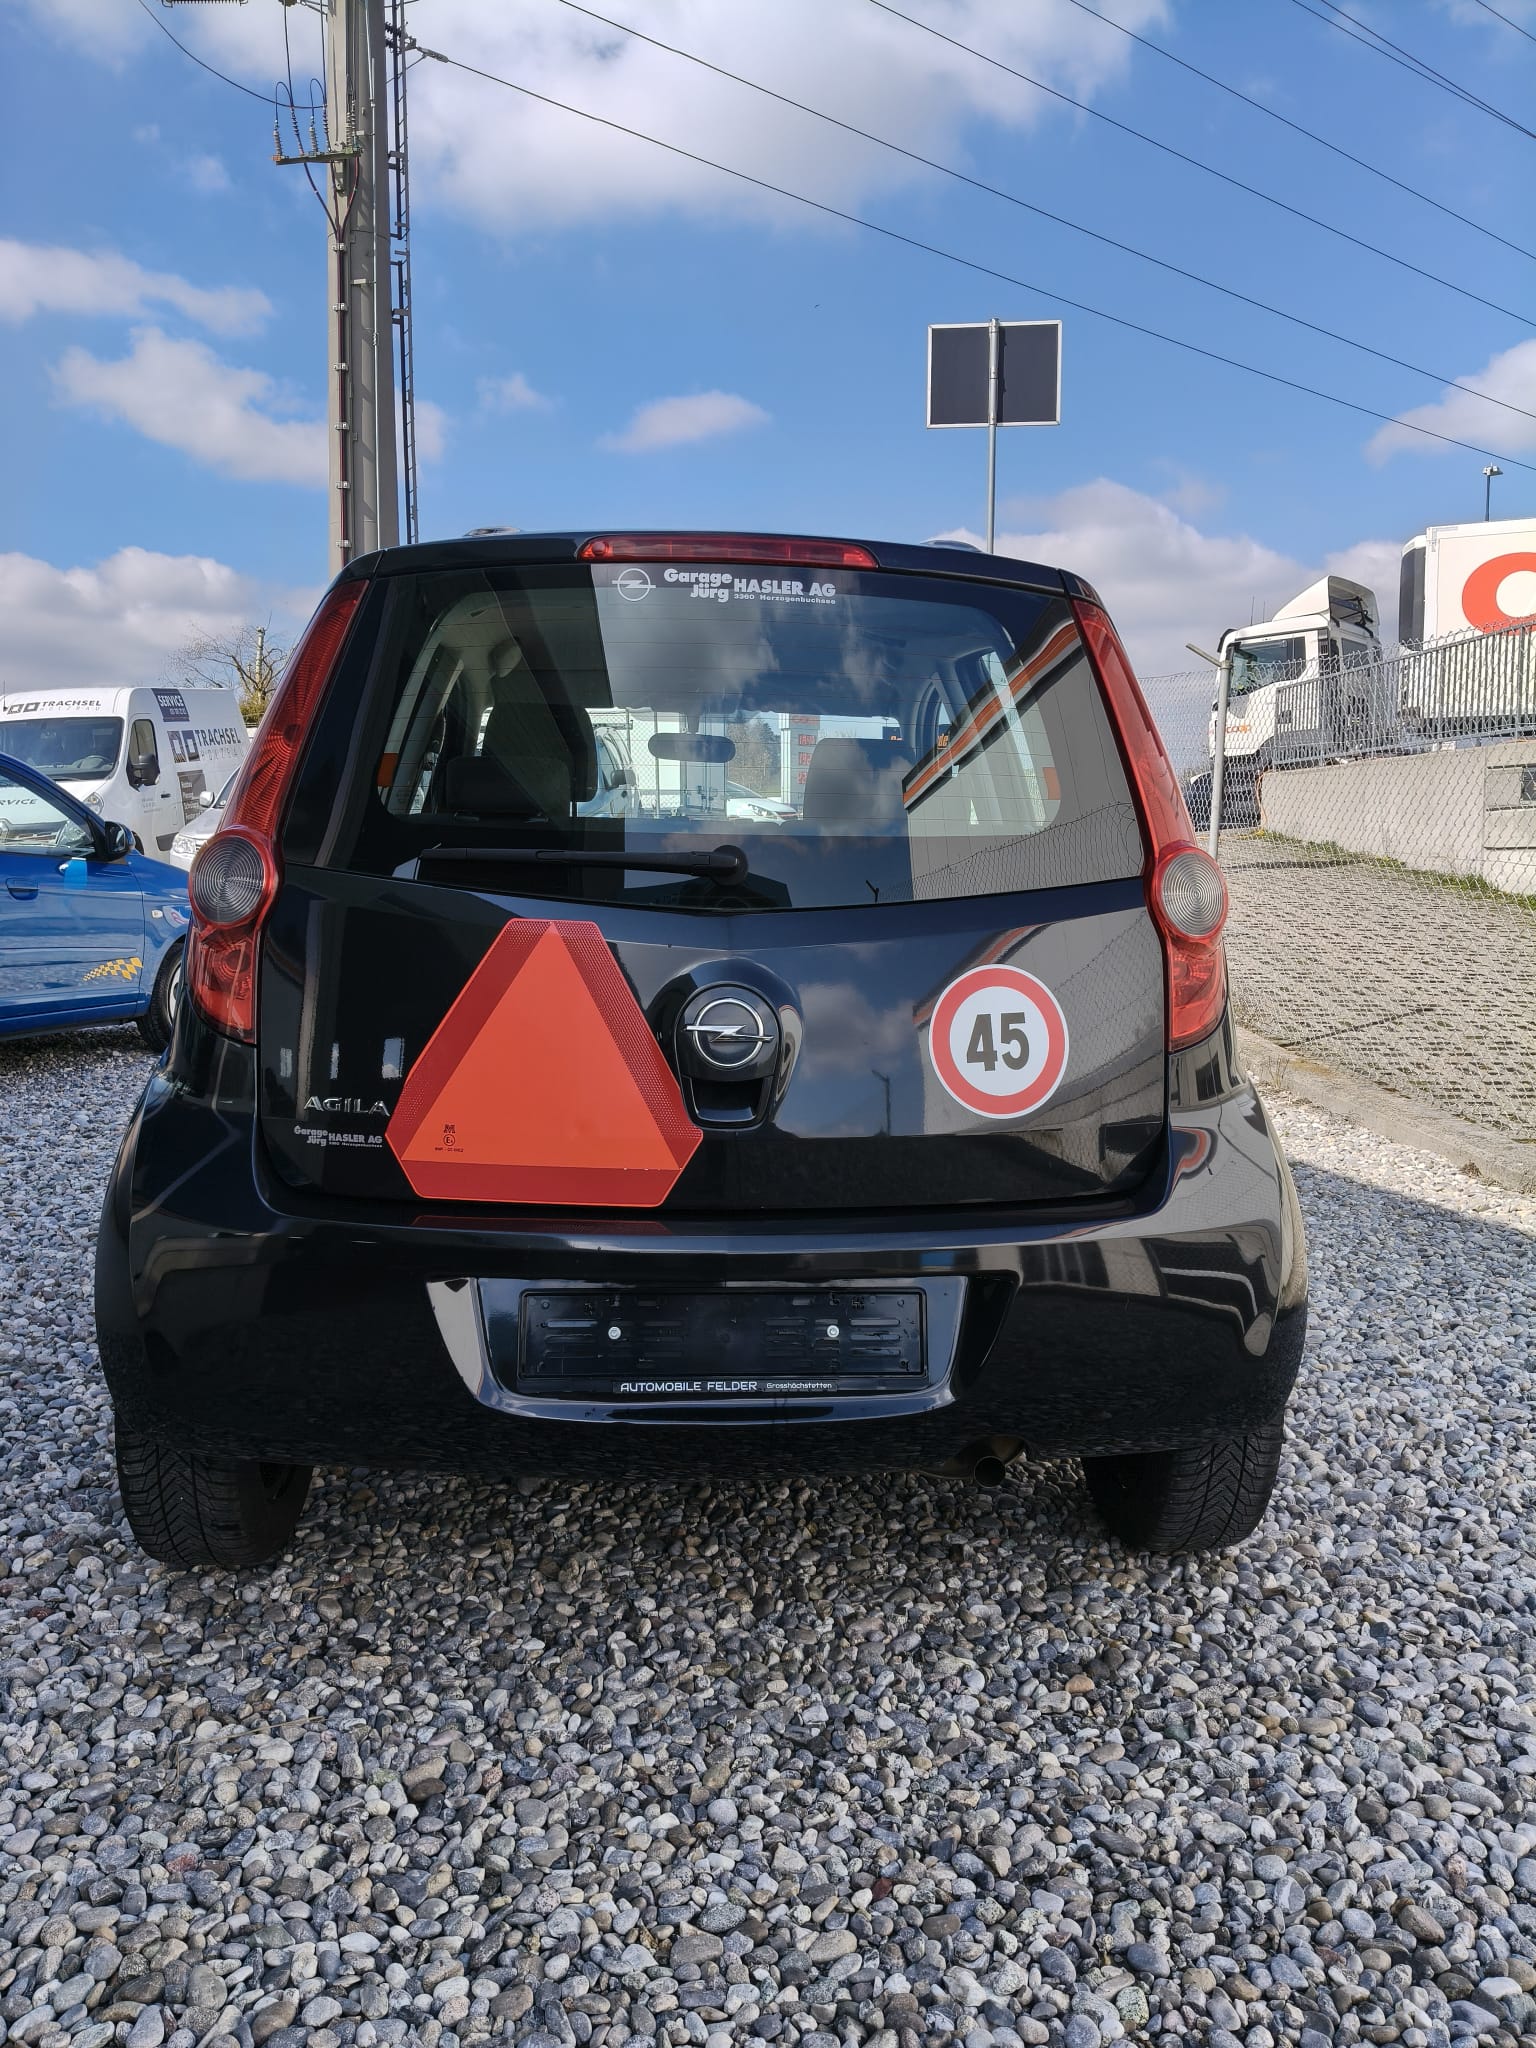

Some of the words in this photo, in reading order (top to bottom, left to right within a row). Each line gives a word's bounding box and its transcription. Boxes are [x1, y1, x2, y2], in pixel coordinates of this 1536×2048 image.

[664, 568, 732, 587] Garage
[690, 584, 729, 602] Jürg
[734, 579, 803, 595] HASLER
[808, 582, 836, 597] AG
[157, 695, 184, 706] SERVICE
[194, 727, 241, 747] TRACHSEL
[966, 1012, 1030, 1072] 45
[303, 1096, 390, 1117] AGILA
[294, 1125, 328, 1138] Garage
[328, 1132, 365, 1143] HASLER
[367, 1135, 383, 1144] AG
[620, 1381, 702, 1393] AUTOMOBILE
[707, 1381, 758, 1391] FELDER
